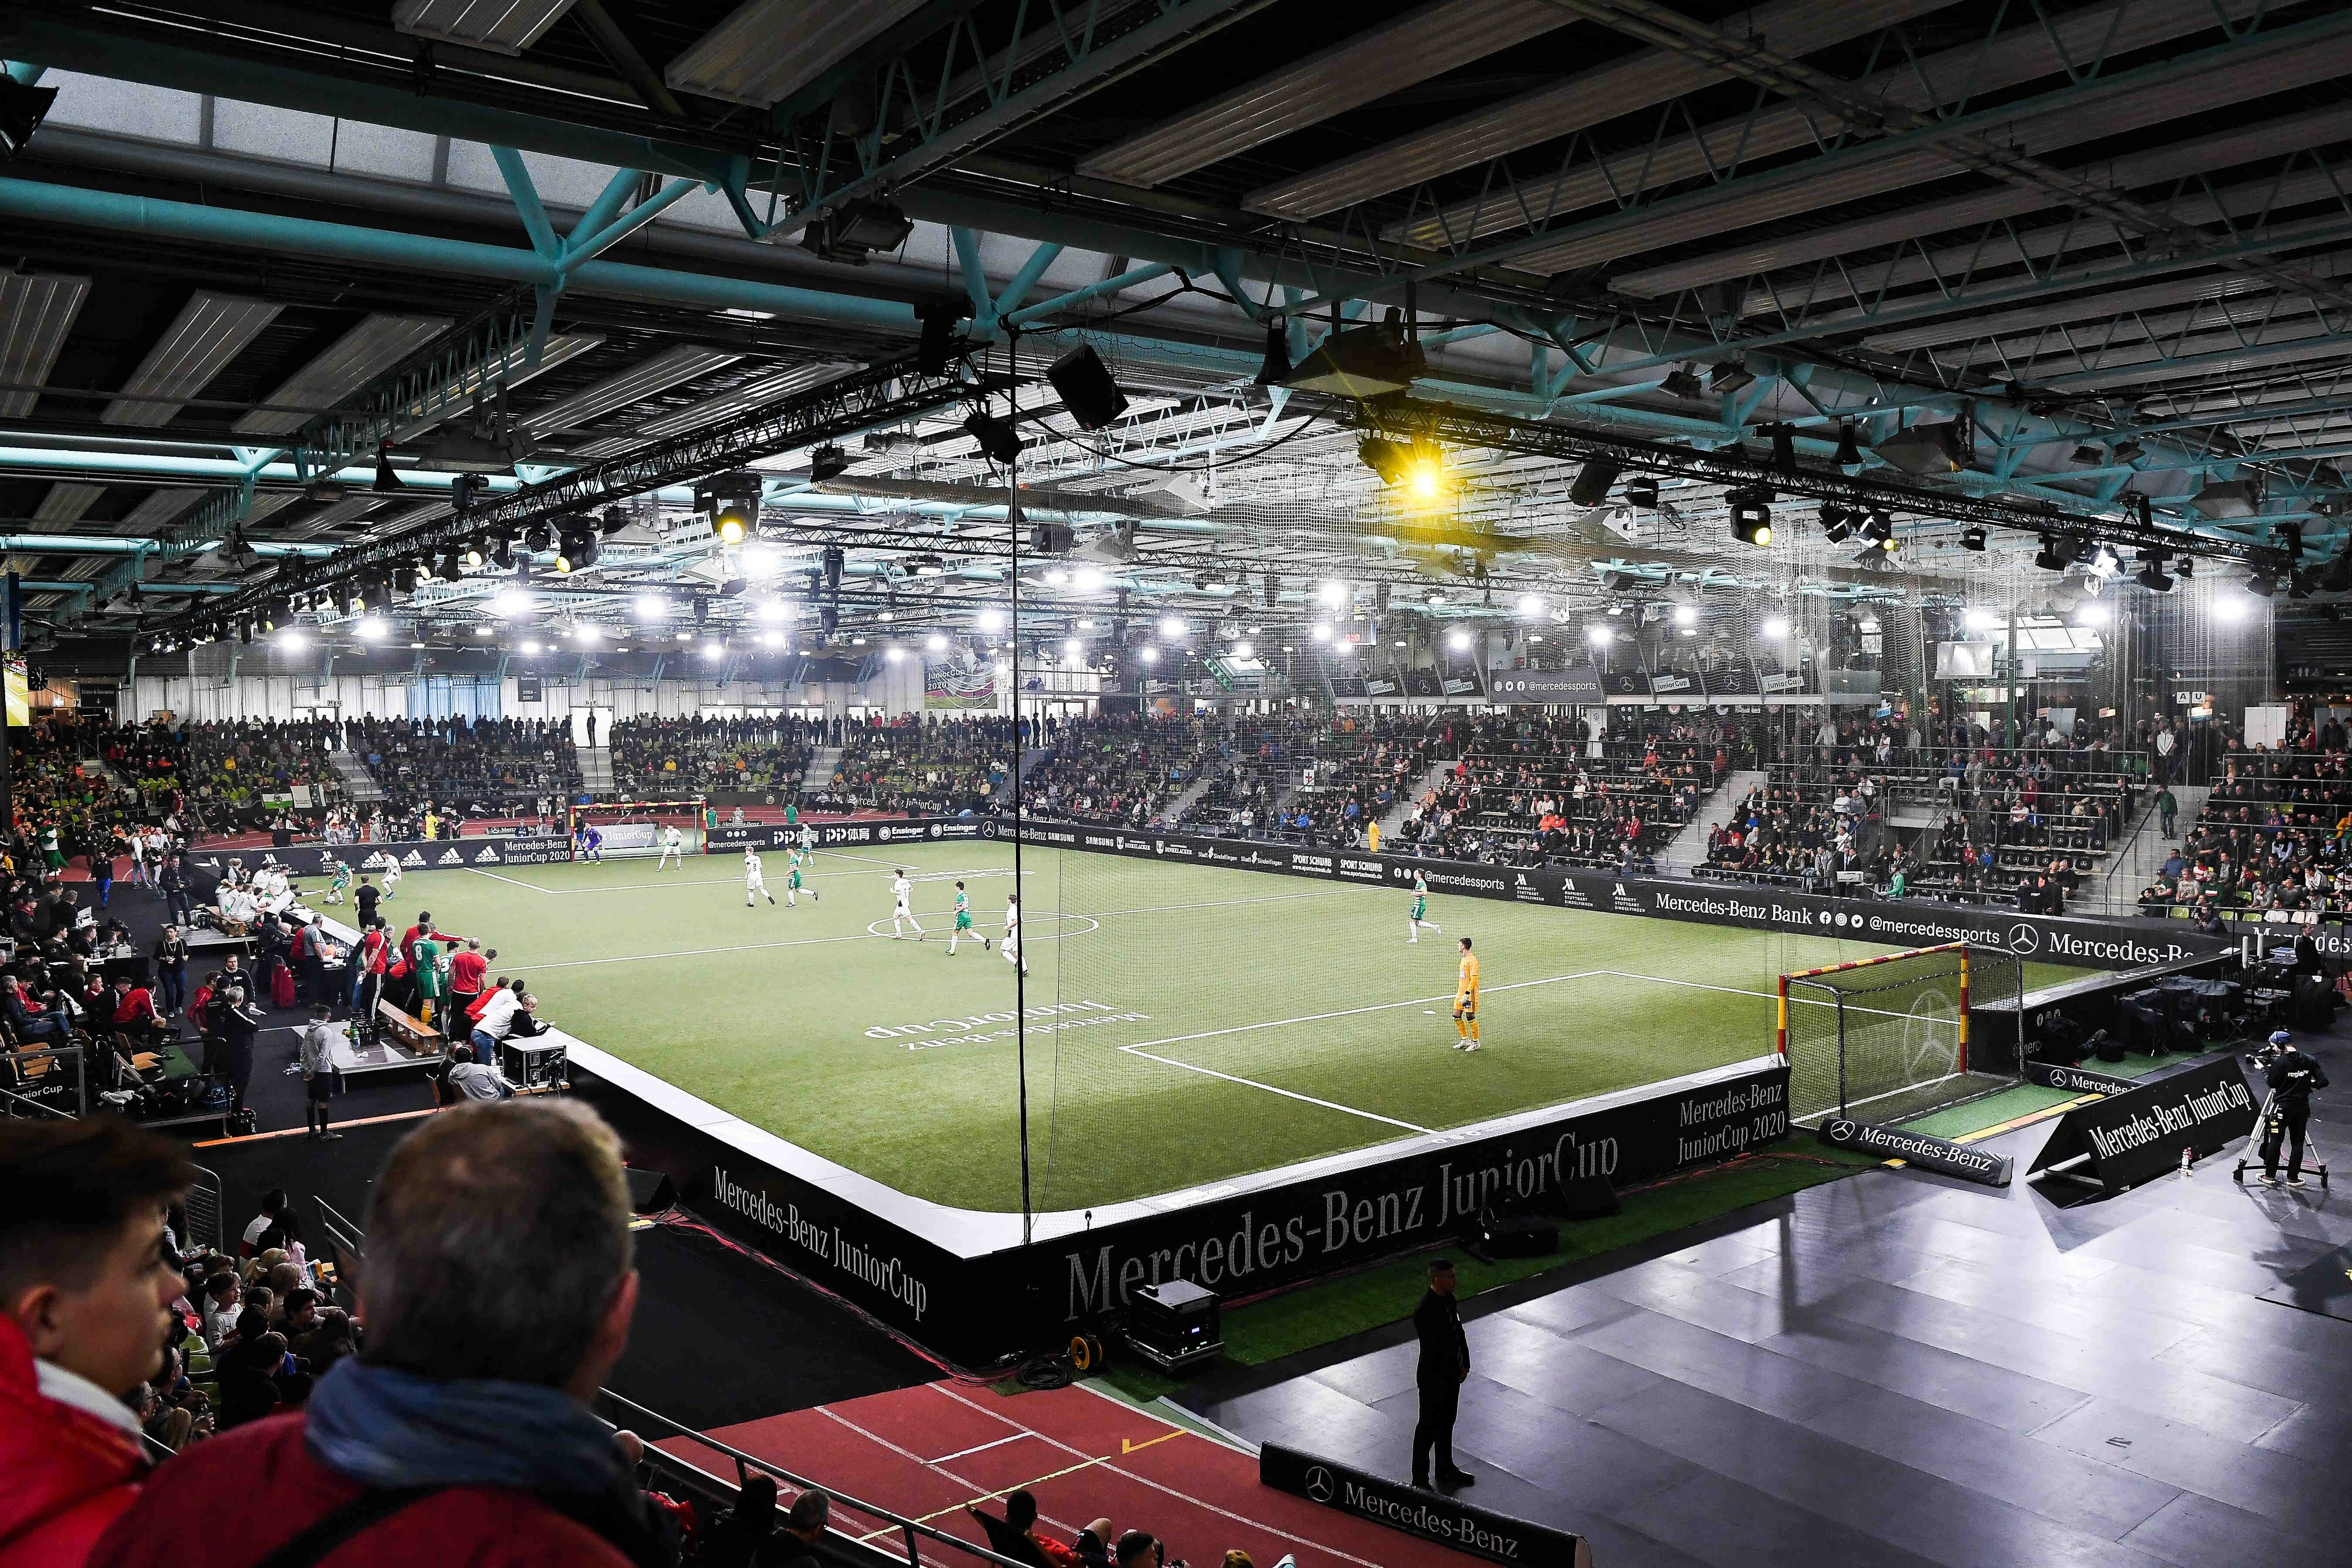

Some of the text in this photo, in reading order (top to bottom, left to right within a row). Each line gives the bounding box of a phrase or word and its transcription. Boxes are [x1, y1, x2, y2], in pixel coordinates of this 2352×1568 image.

[1448, 684, 1472, 693] JuniorCup
[1529, 681, 1597, 692] @mercedessports
[1657, 681, 1687, 689] JuniorCup
[610, 829, 652, 842] JuniorCup
[892, 826, 925, 835] Ensinger
[1048, 832, 1075, 842] SAMSUNG
[504, 839, 567, 851] Mercedes-Benz
[708, 839, 766, 848] @mercedessports
[1086, 835, 1114, 847] SAMSUNG
[505, 850, 570, 865] JuniorCup 2020
[1213, 853, 1238, 862] Sindelfingen
[1257, 858, 1283, 866] Sindelfingen
[1293, 854, 1332, 866] SPORT SCHWAB
[1340, 859, 1383, 872] SPORT SCHWAB
[1340, 870, 1382, 879] www.sportschwab.de
[1425, 870, 1505, 890] @mercedessports
[1656, 893, 1813, 925] Mercedes-Benz Bank
[1870, 916, 2000, 944] @mercedessports
[415, 945, 422, 961] 8
[1679, 1084, 1782, 1127] Mercedes-Benz
[2088, 1080, 2251, 1160] Mercedes-Benz JuniorCup
[1678, 1110, 1785, 1165] JuniorCup 2020
[1859, 1127, 1993, 1171] Mercedes-Benz
[715, 1165, 927, 1323] Mercedes-Benz JuniorCup
[1064, 1186, 1424, 1323] Mercedes-Benz
[1345, 1482, 1518, 1558] Mercedes-Benz
